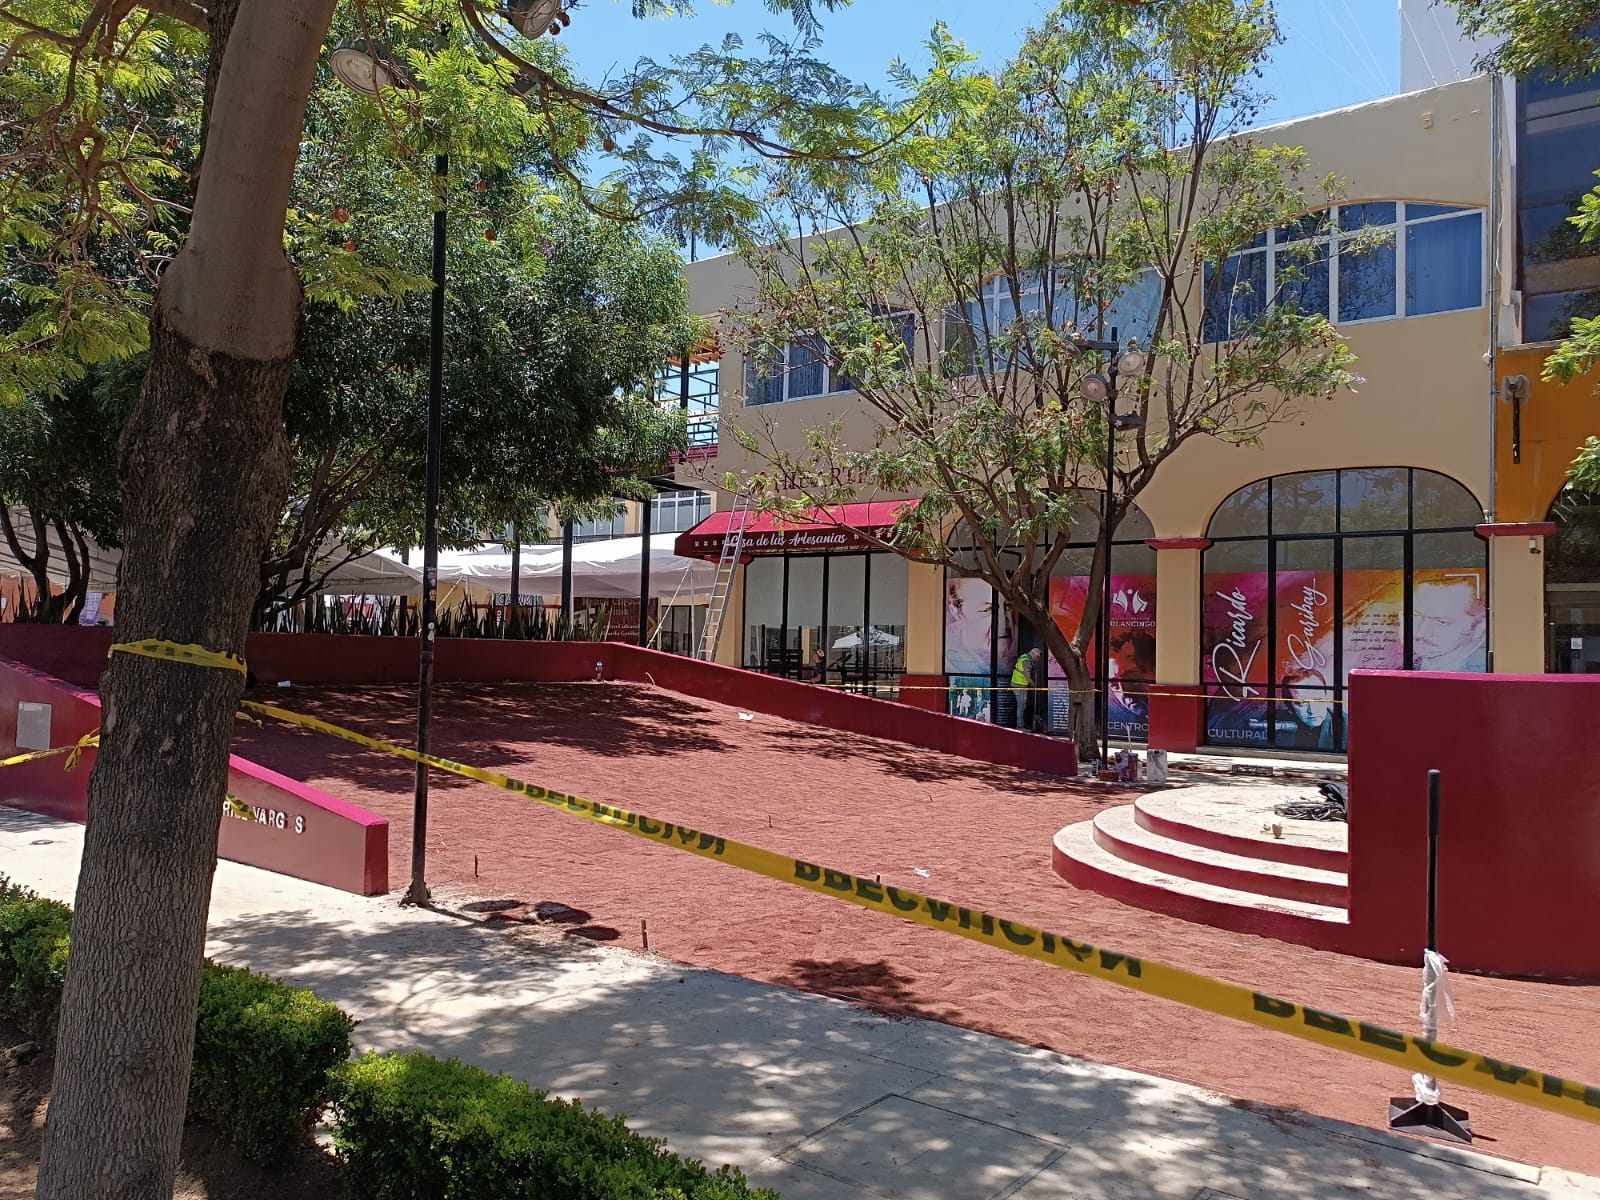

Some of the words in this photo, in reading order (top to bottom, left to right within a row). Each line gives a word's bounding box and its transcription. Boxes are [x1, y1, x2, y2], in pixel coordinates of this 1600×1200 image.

[730, 534, 754, 547] Csa
[756, 533, 769, 546] de
[770, 533, 785, 546] las
[1109, 620, 1156, 628] ULANCINGO
[1287, 577, 1328, 670] Garibay
[1212, 586, 1261, 702] Ricardo
[1107, 721, 1149, 732] CENTRO
[1207, 727, 1268, 740] CULTURAL
